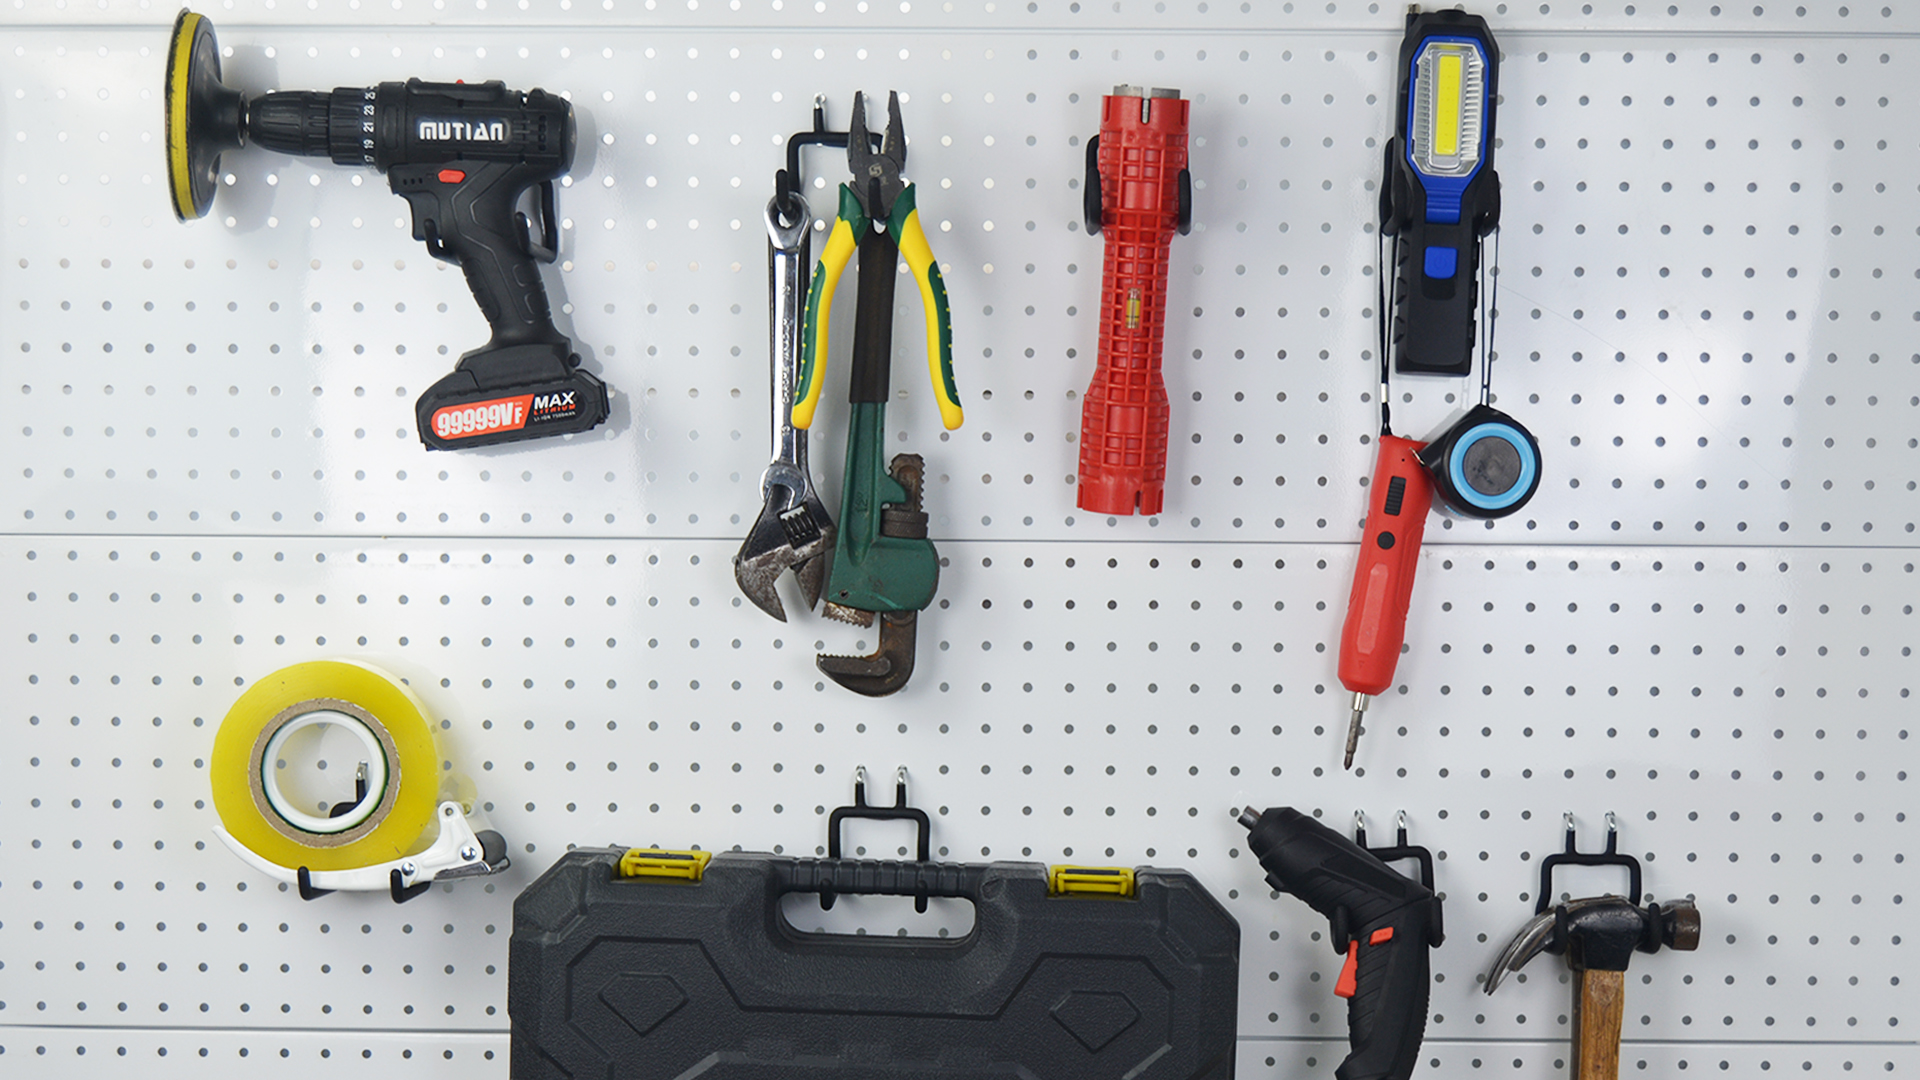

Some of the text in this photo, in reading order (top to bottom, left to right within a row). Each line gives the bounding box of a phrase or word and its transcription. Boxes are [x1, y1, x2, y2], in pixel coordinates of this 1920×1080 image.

[363, 104, 375, 116] 23
[362, 121, 374, 133] 21
[419, 121, 504, 141] MUTIAN
[363, 138, 374, 149] 19
[534, 391, 576, 410] MAX
